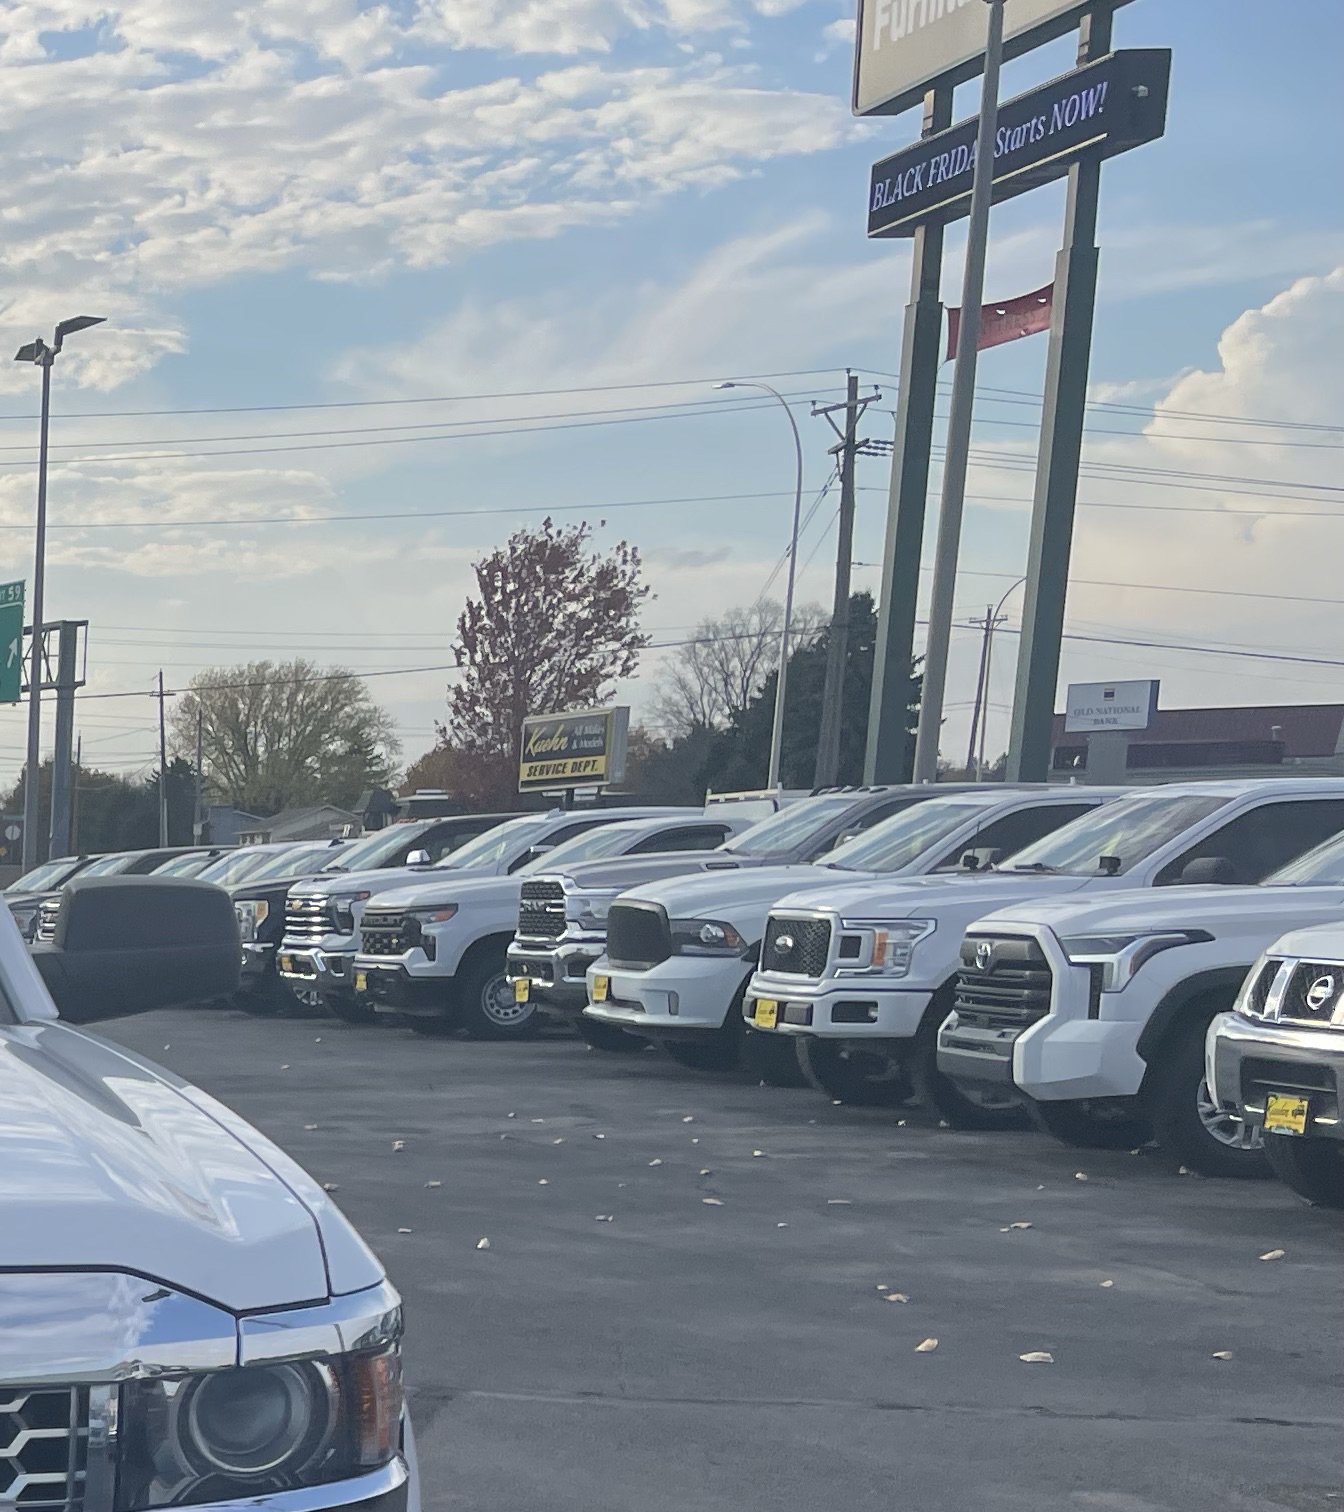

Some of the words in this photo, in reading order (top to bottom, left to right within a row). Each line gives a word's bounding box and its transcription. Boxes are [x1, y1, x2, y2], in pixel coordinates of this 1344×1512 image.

[871, 161, 927, 212] BLACK
[926, 138, 979, 188] FRIDA
[994, 115, 1046, 159] Starts
[1048, 81, 1109, 135] NOW!
[8, 585, 21, 601] 59
[525, 724, 568, 757] Kuehn
[527, 762, 568, 777] SERVICE
[570, 759, 598, 774] DEPT.
